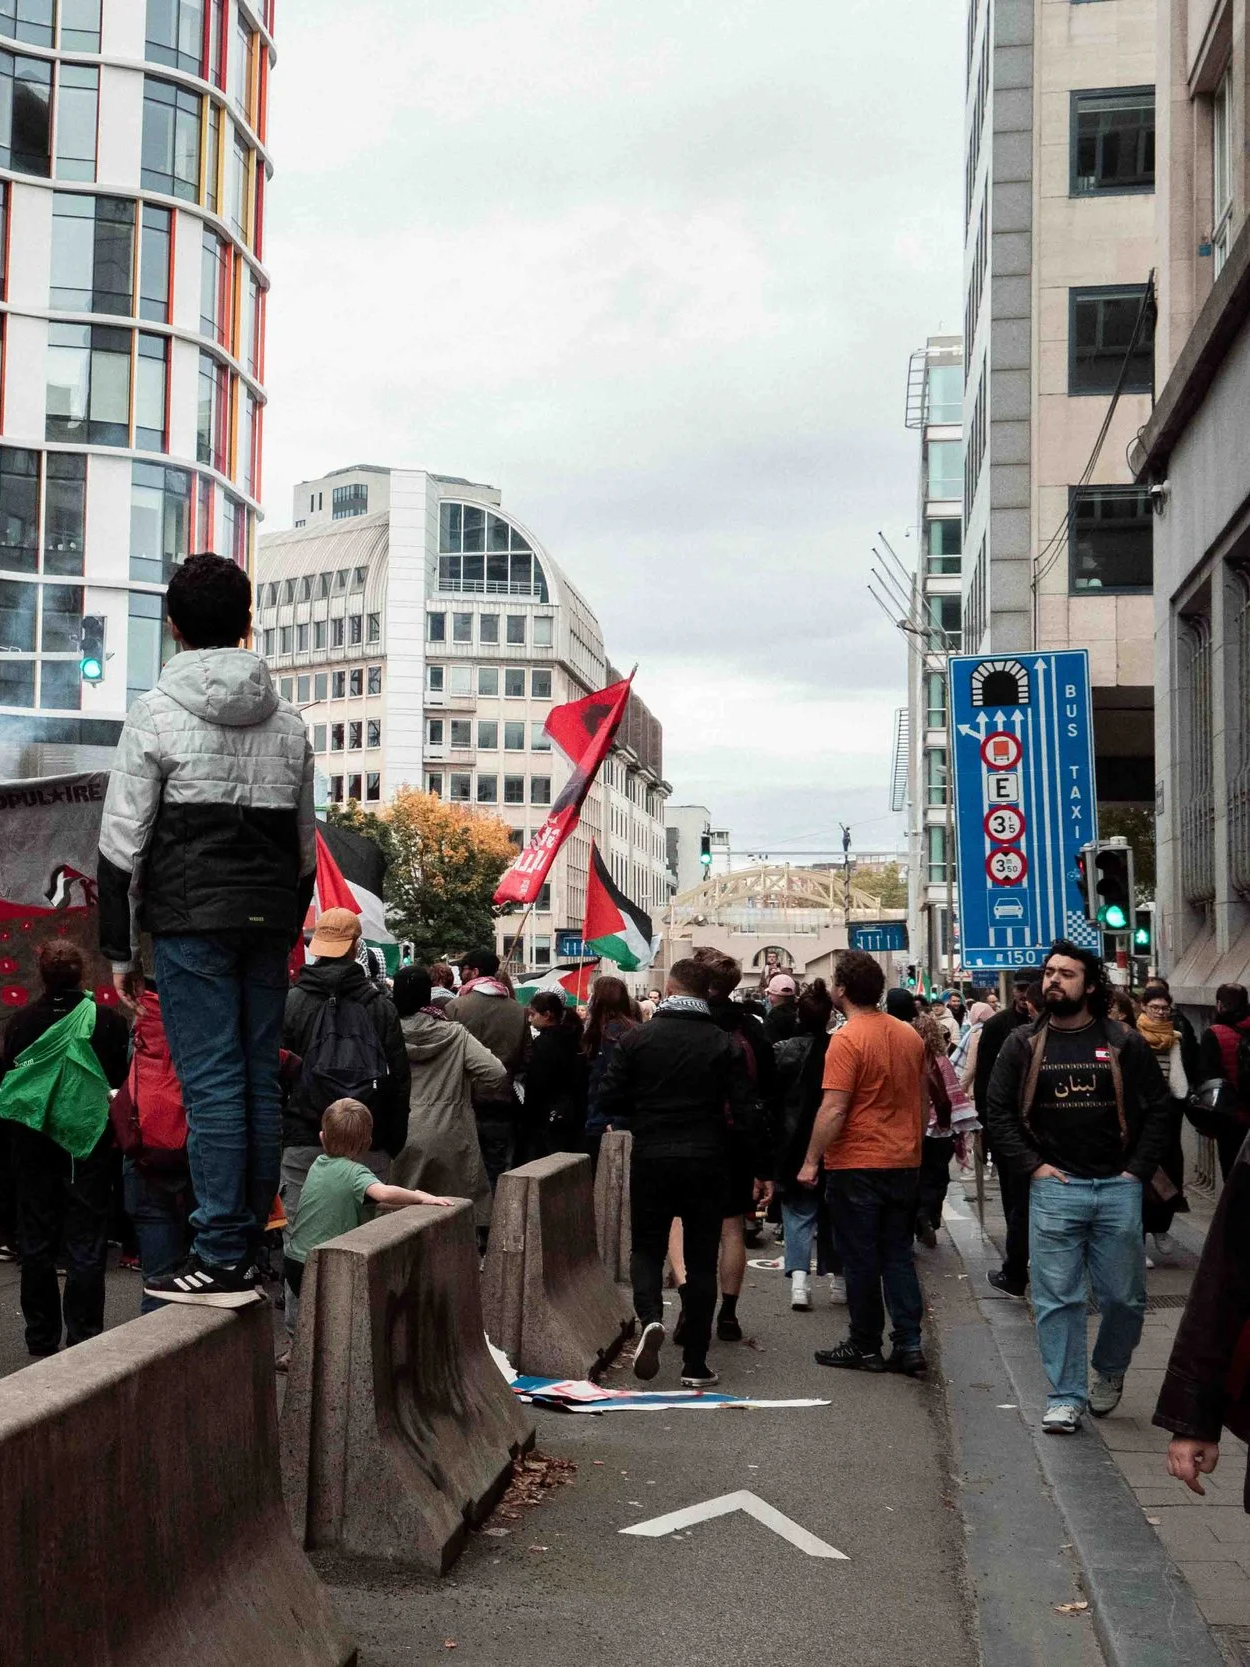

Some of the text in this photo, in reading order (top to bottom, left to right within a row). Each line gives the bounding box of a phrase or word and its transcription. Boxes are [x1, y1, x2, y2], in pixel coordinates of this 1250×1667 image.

[1065, 684, 1082, 839] BUS TAXI
[996, 778, 1010, 798] E
[1007, 950, 1036, 964] 150
[1054, 1074, 1097, 1098] لبنان
